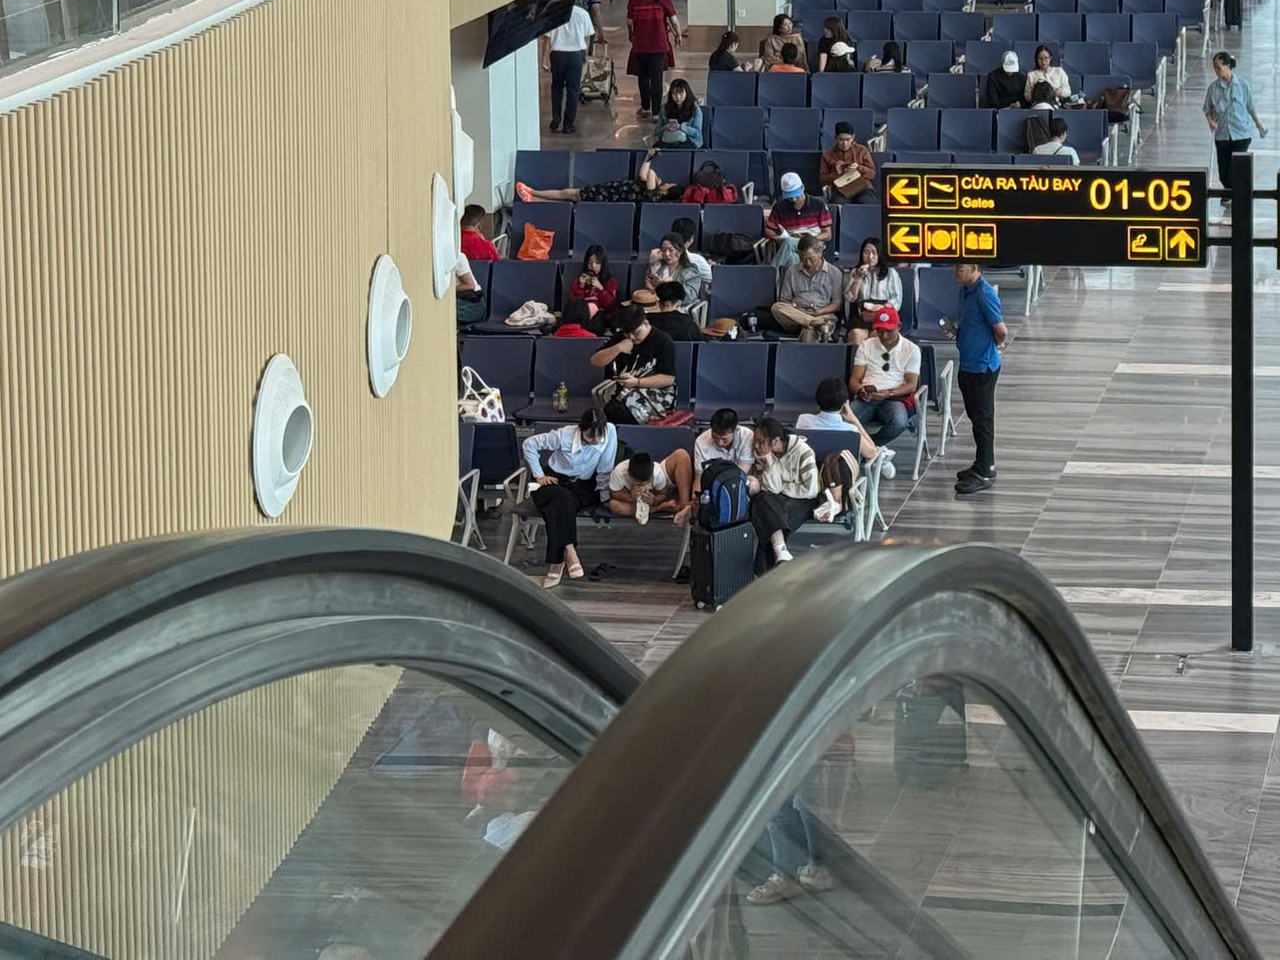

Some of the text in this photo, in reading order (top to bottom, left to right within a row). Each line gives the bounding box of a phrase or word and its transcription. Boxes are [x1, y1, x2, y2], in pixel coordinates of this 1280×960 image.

[962, 174, 1192, 211] CỬA RA TÀU BAY 01-05
[962, 197, 995, 209] Gates
